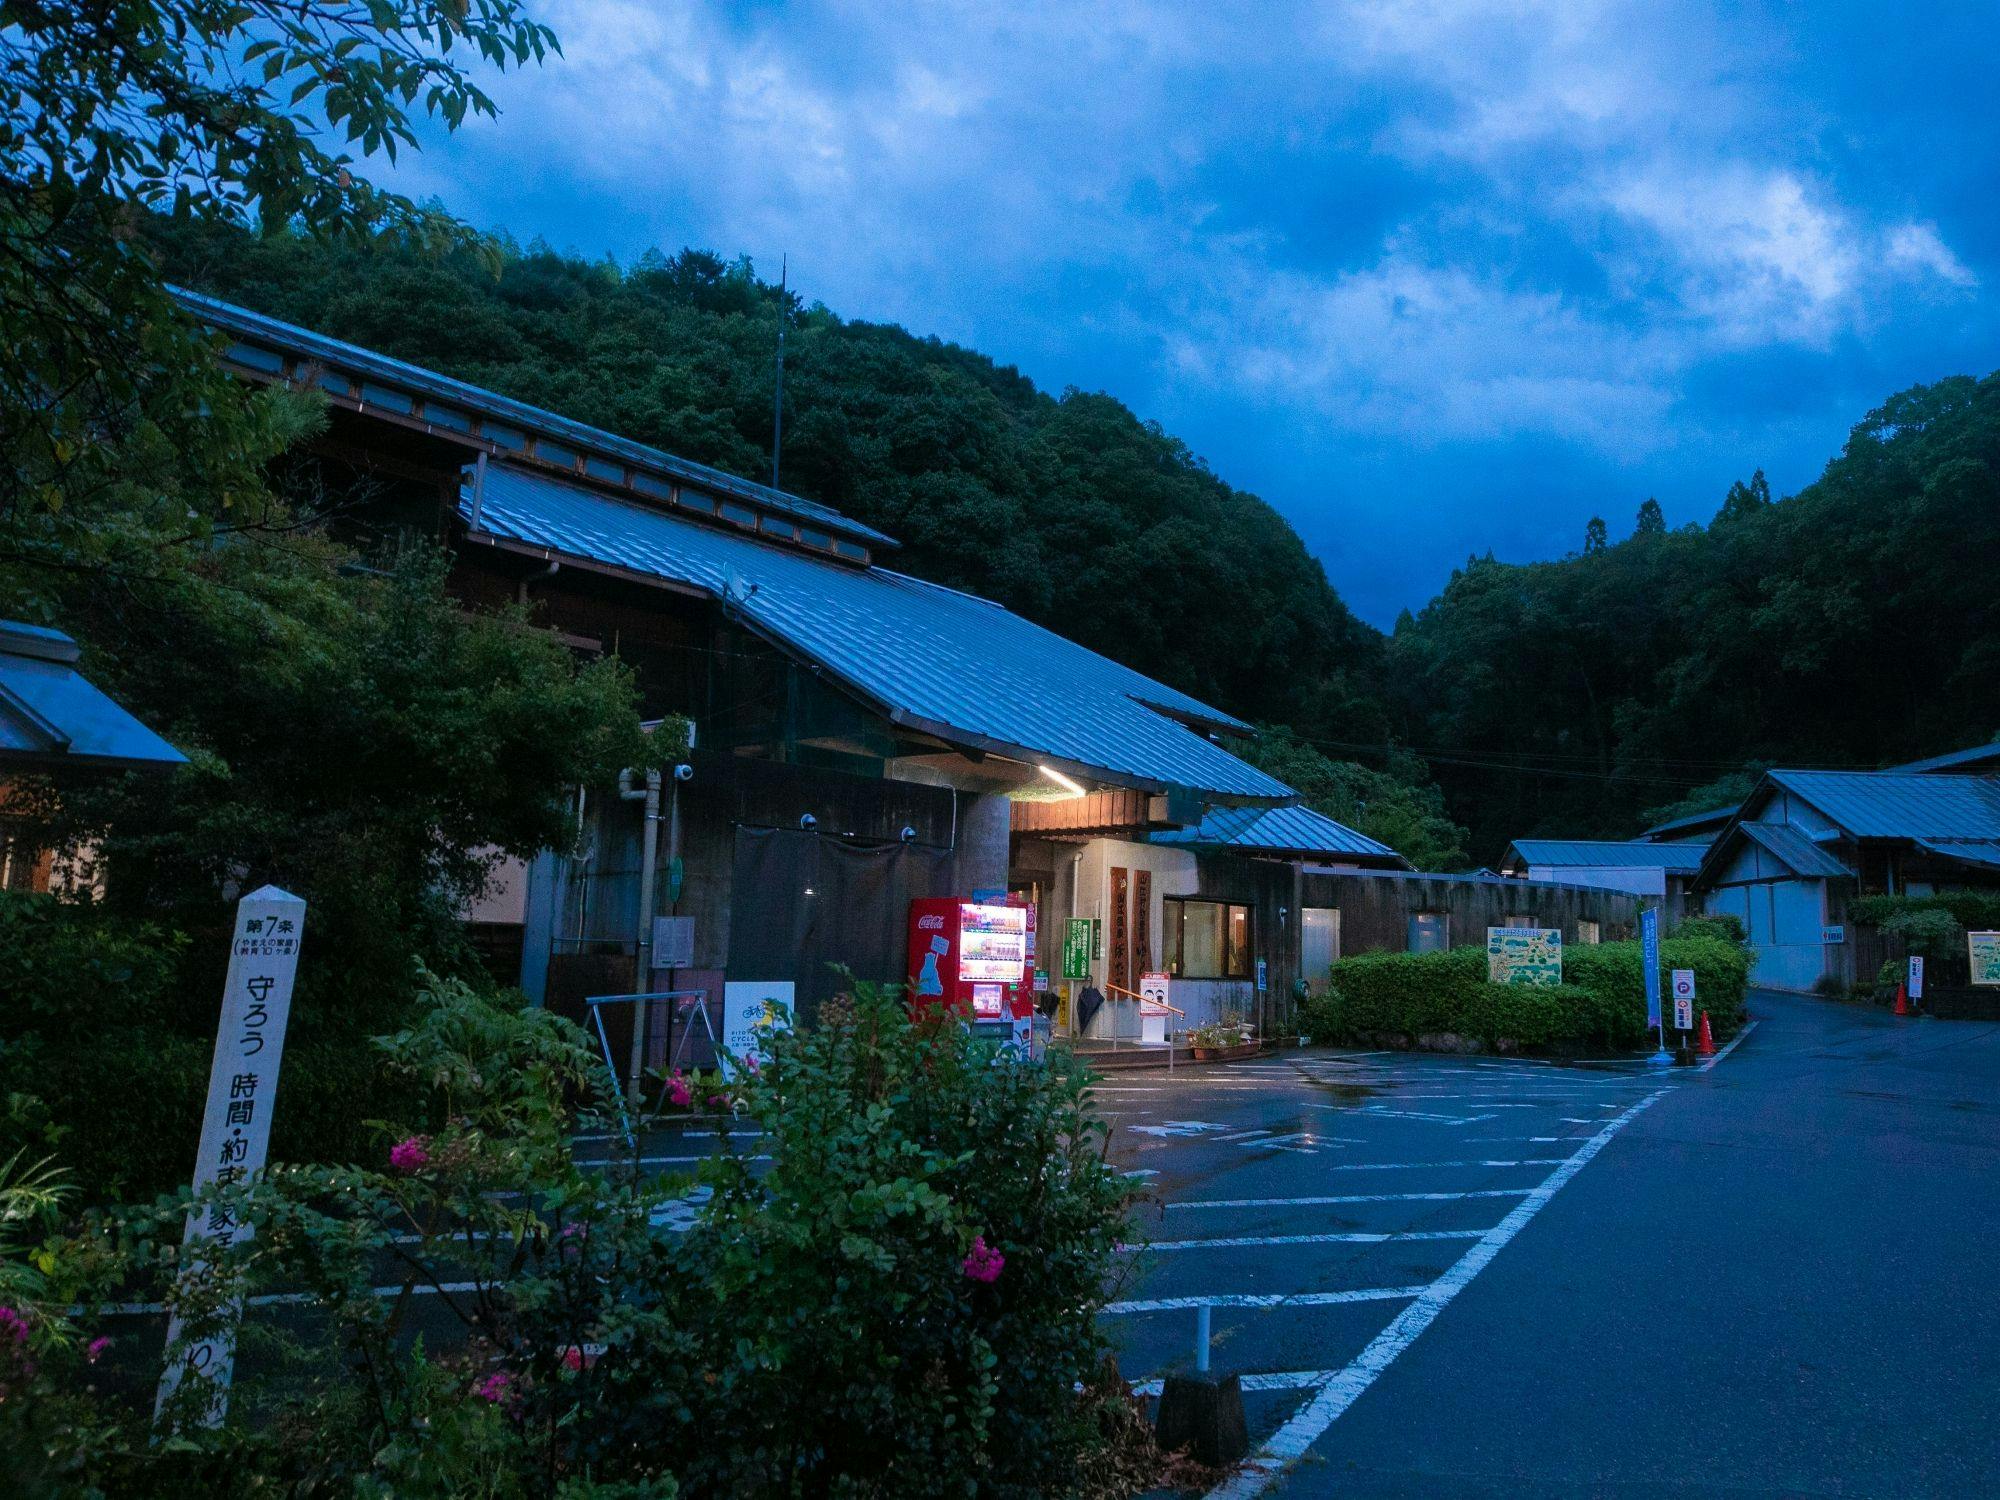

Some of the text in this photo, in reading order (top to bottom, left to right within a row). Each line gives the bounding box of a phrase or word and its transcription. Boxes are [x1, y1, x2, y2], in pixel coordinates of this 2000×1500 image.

[245, 915, 295, 938] 第7条
[918, 914, 945, 929] Coca-Cola
[239, 975, 275, 1057] 守ろう
